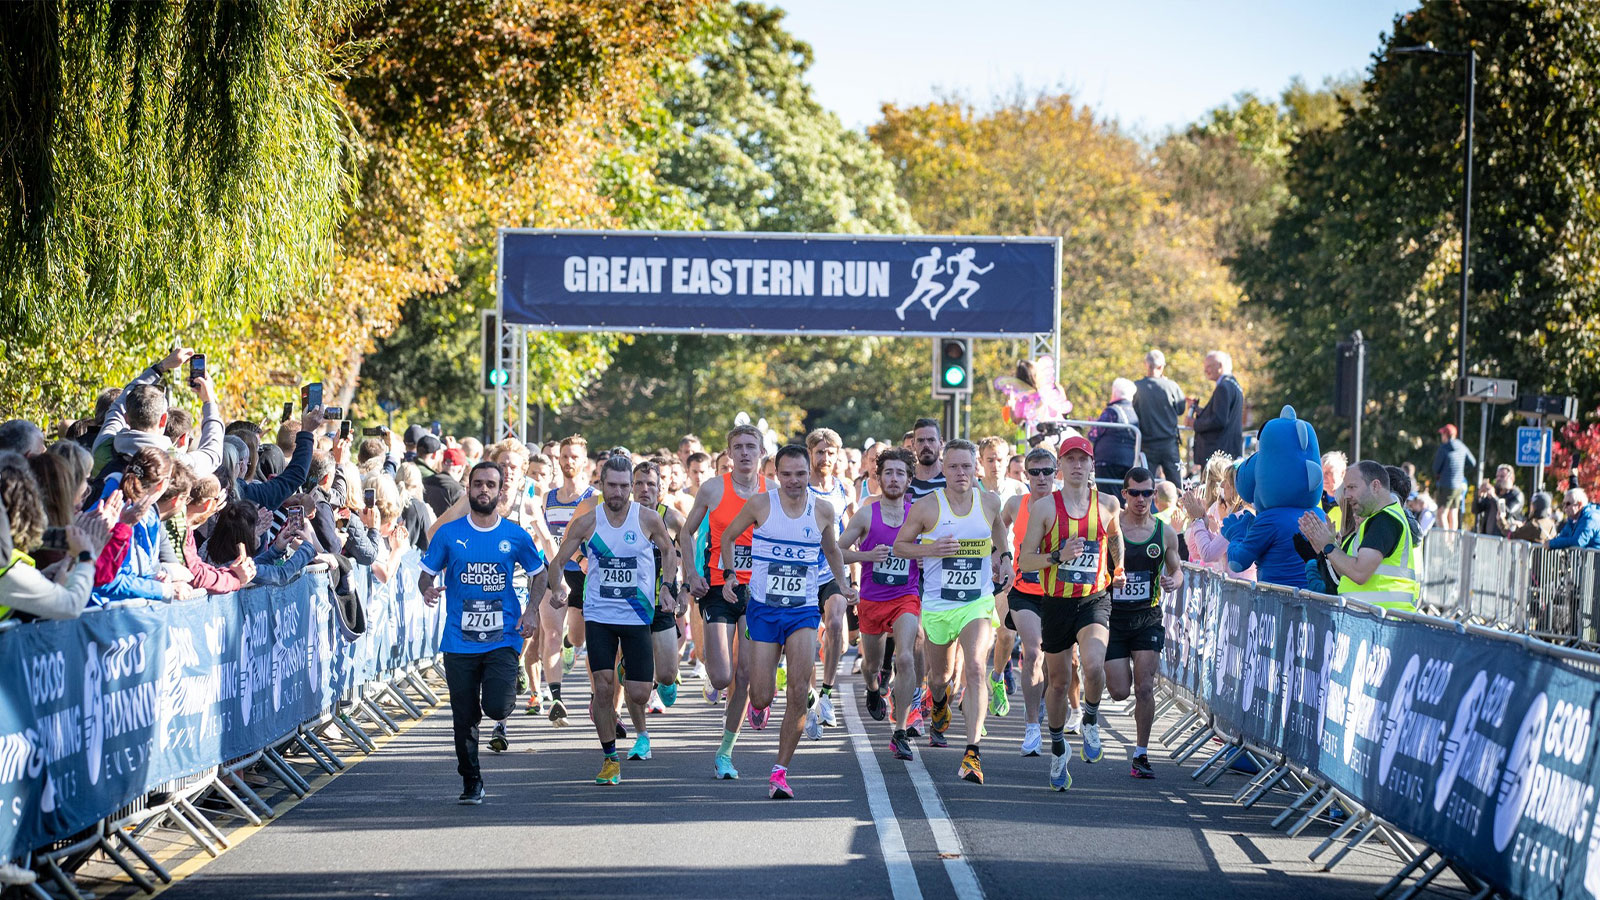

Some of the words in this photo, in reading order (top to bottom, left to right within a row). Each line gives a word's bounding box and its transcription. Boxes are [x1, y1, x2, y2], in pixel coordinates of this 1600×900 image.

[564, 256, 667, 294] GREAT
[672, 258, 815, 297] EASTERN
[822, 261, 891, 298] RUN
[772, 546, 781, 556] C
[784, 547, 794, 558] &
[797, 549, 806, 559] C
[467, 563, 498, 574] MICK
[603, 569, 632, 582] 2480
[460, 573, 506, 585] GEORGE
[771, 576, 802, 592] 2165
[947, 570, 977, 585] 2265
[1119, 583, 1146, 596] 1855
[467, 613, 496, 627] 2761
[1259, 613, 1276, 649] GOOD
[102, 632, 147, 682] GOOD
[32, 651, 65, 706] GOOD
[1544, 699, 1590, 765] GOOD
[1525, 763, 1594, 844] RUNNING
